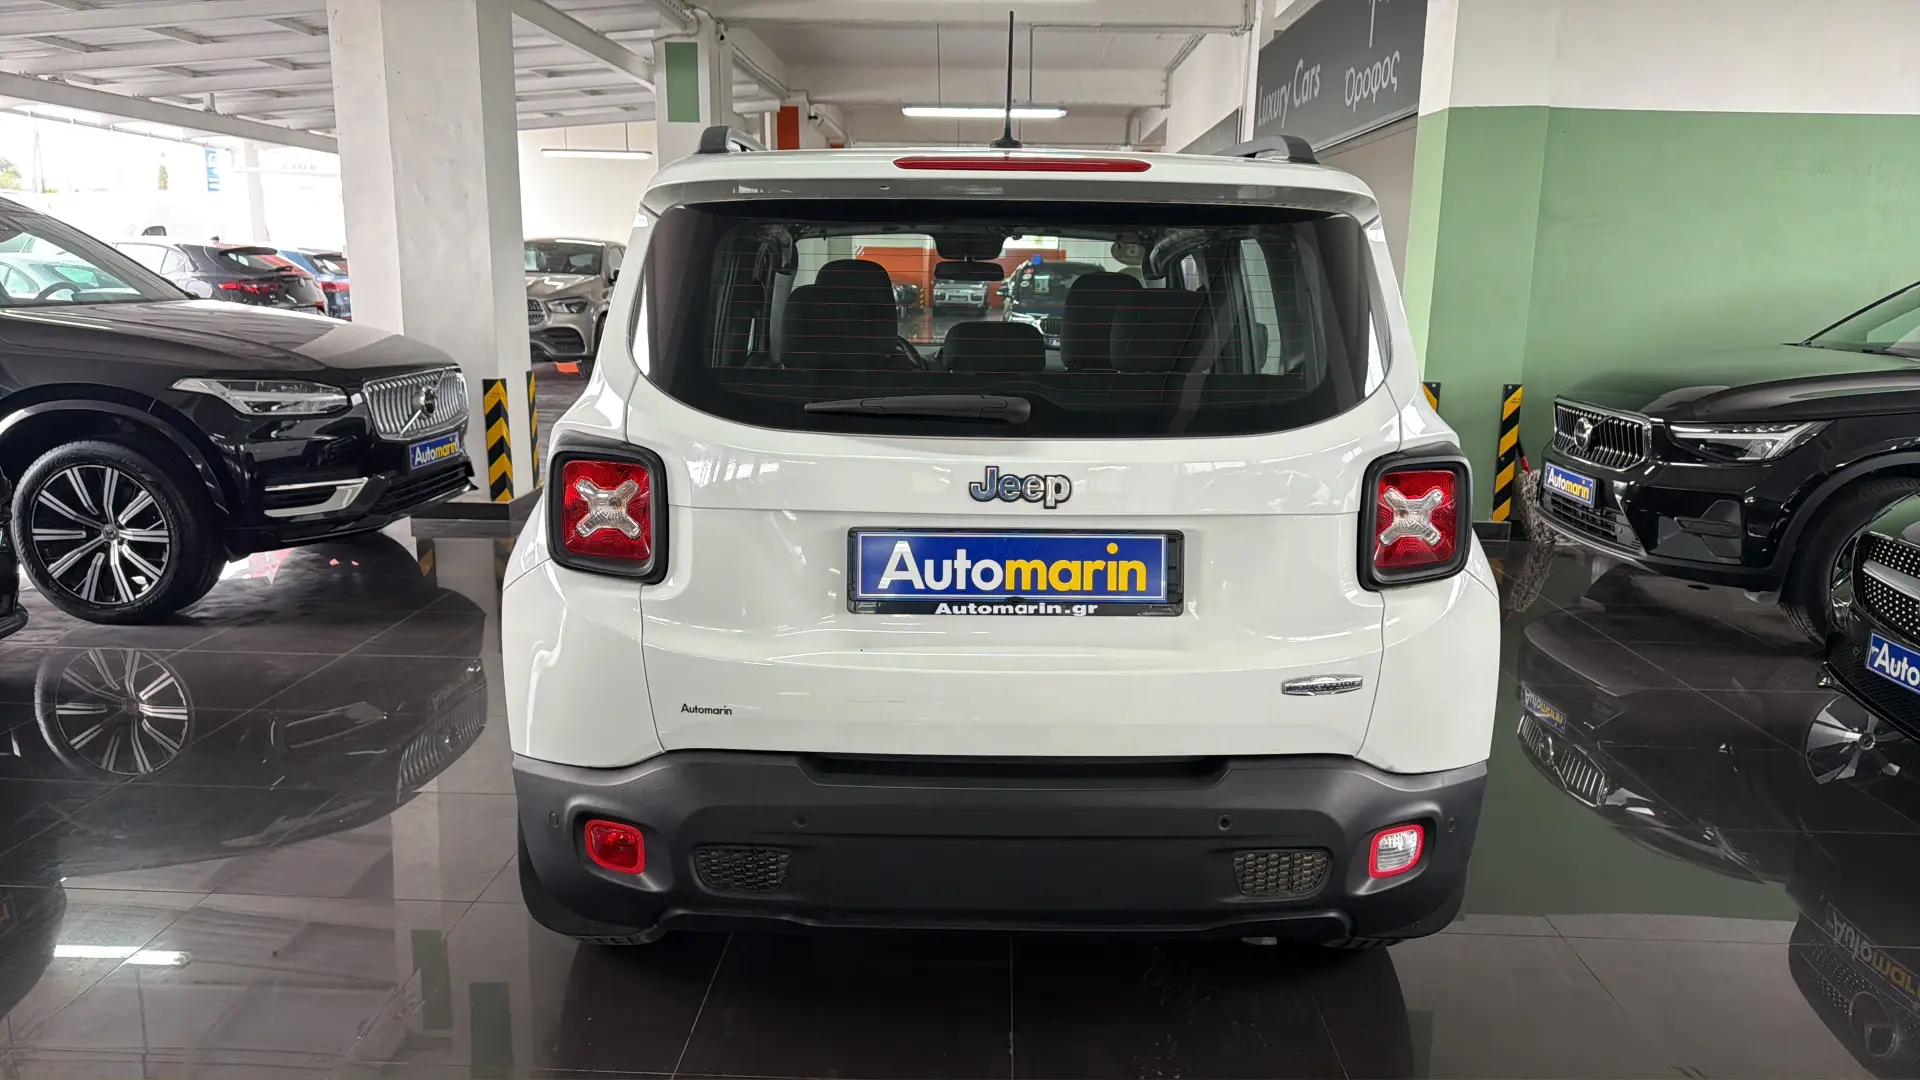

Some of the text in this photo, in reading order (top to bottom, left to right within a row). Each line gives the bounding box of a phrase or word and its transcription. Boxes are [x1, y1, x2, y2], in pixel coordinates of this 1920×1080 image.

[1257, 58, 1321, 129] Luxury Cars
[414, 436, 458, 466] Automarin
[969, 465, 1072, 509] Jeep
[1547, 467, 1590, 500] Automarin
[877, 540, 1147, 591] Automarin
[934, 602, 1098, 616] Automarin.gr
[680, 702, 733, 716] Automarin
